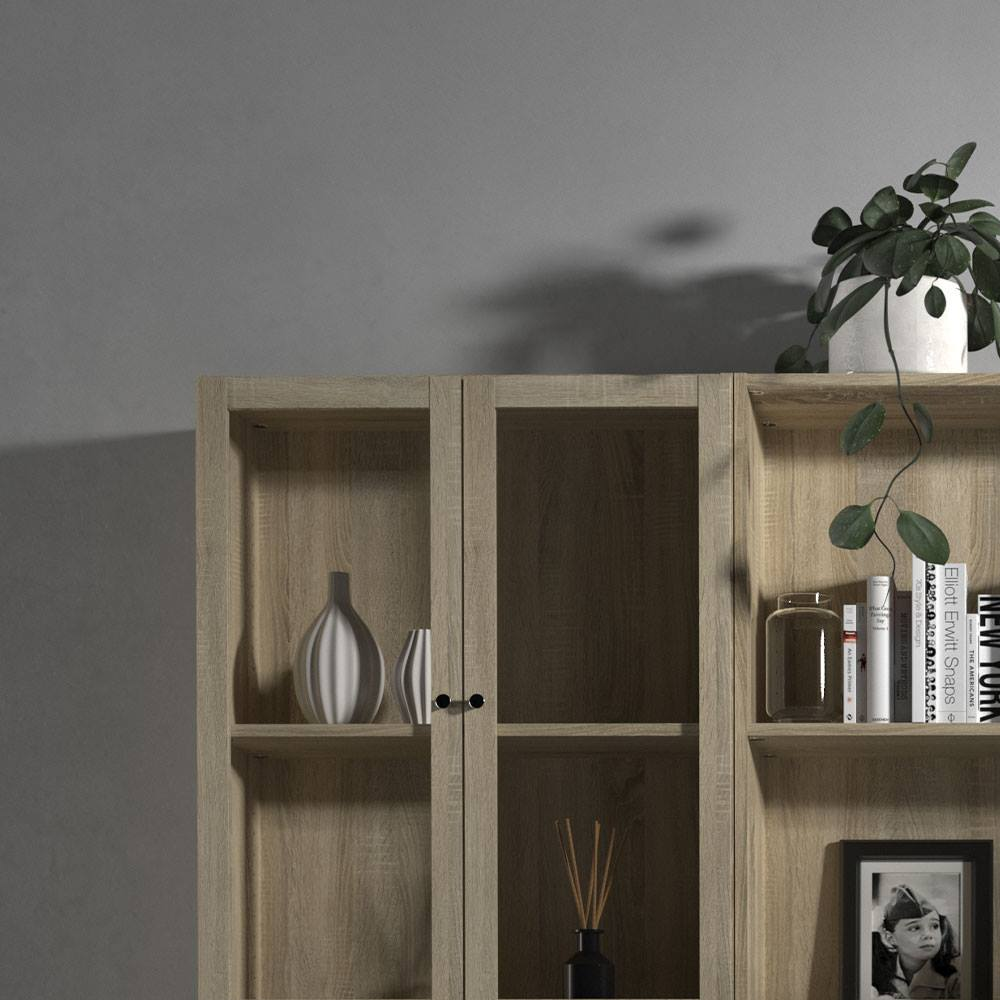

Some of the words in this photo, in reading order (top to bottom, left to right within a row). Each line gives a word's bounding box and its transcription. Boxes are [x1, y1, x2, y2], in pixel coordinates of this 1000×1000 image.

[944, 567, 959, 605] Elliott
[944, 611, 959, 652] Erwitt
[942, 657, 959, 705] Snaps
